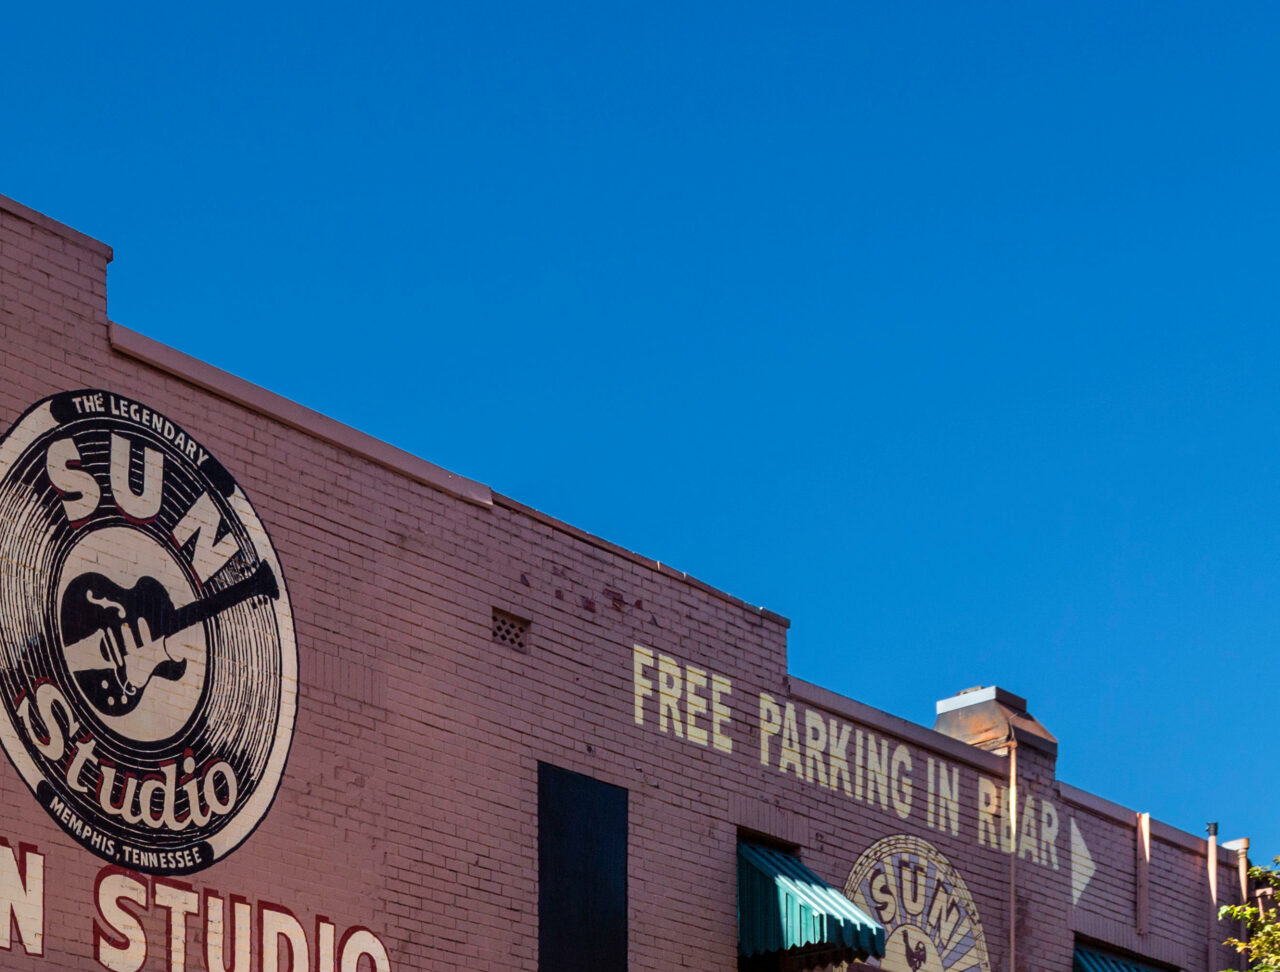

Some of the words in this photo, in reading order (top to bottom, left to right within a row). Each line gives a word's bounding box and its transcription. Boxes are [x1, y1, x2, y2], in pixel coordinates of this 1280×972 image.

[73, 395, 106, 414] THE
[110, 394, 209, 466] LEGENDARY
[45, 430, 241, 593] SUN
[17, 678, 239, 834] Studio
[634, 644, 733, 755] FREE
[759, 691, 913, 819] PARKING
[926, 757, 961, 838] IN
[122, 846, 203, 872] TENNESSEE
[867, 858, 960, 953] SUN
